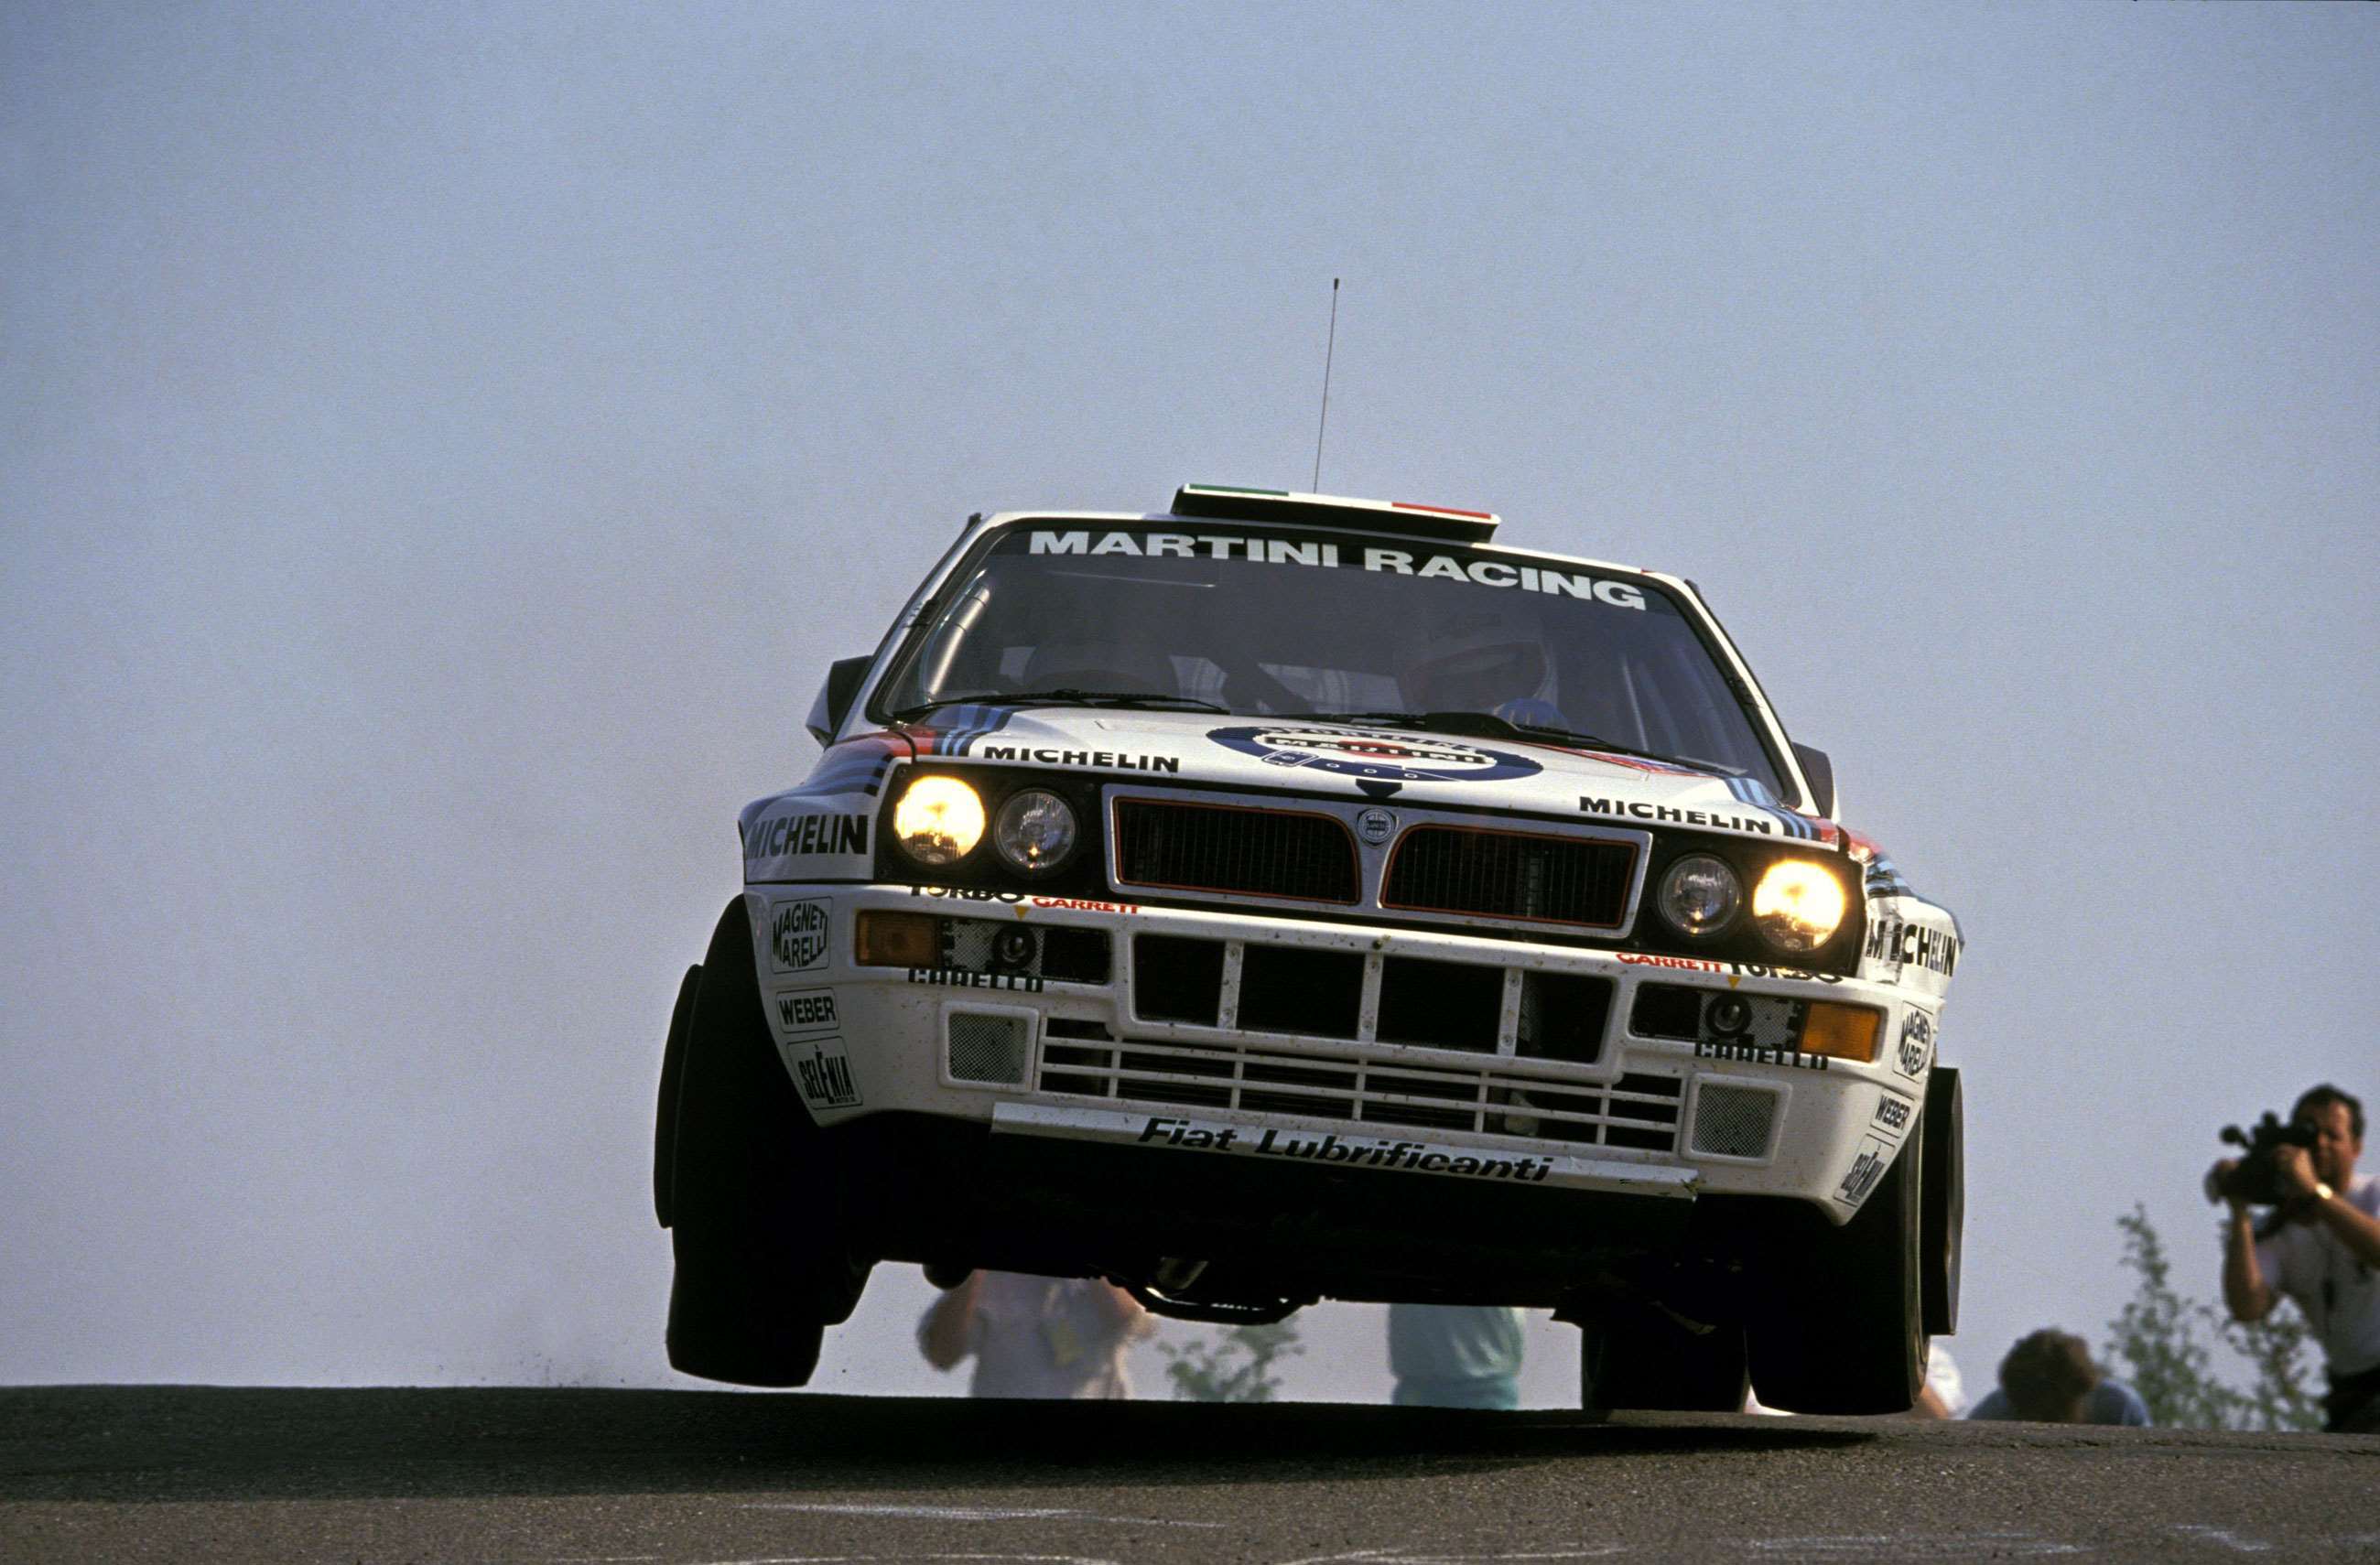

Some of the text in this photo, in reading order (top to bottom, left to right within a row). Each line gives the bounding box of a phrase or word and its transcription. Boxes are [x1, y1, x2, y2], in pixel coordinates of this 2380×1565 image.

[1029, 531, 1647, 610] MARTINI RACING
[984, 746, 1180, 773] MICHELIN
[1579, 795, 1771, 835] MICHELIN
[745, 814, 869, 859] MICHELIN
[1032, 896, 1143, 915] GARRETT
[1615, 952, 1724, 974] GARRETT
[1865, 918, 1957, 977] MICHELIN
[779, 995, 837, 1026] WEBER
[1138, 1117, 1554, 1182] Fiat Lubrificanti
